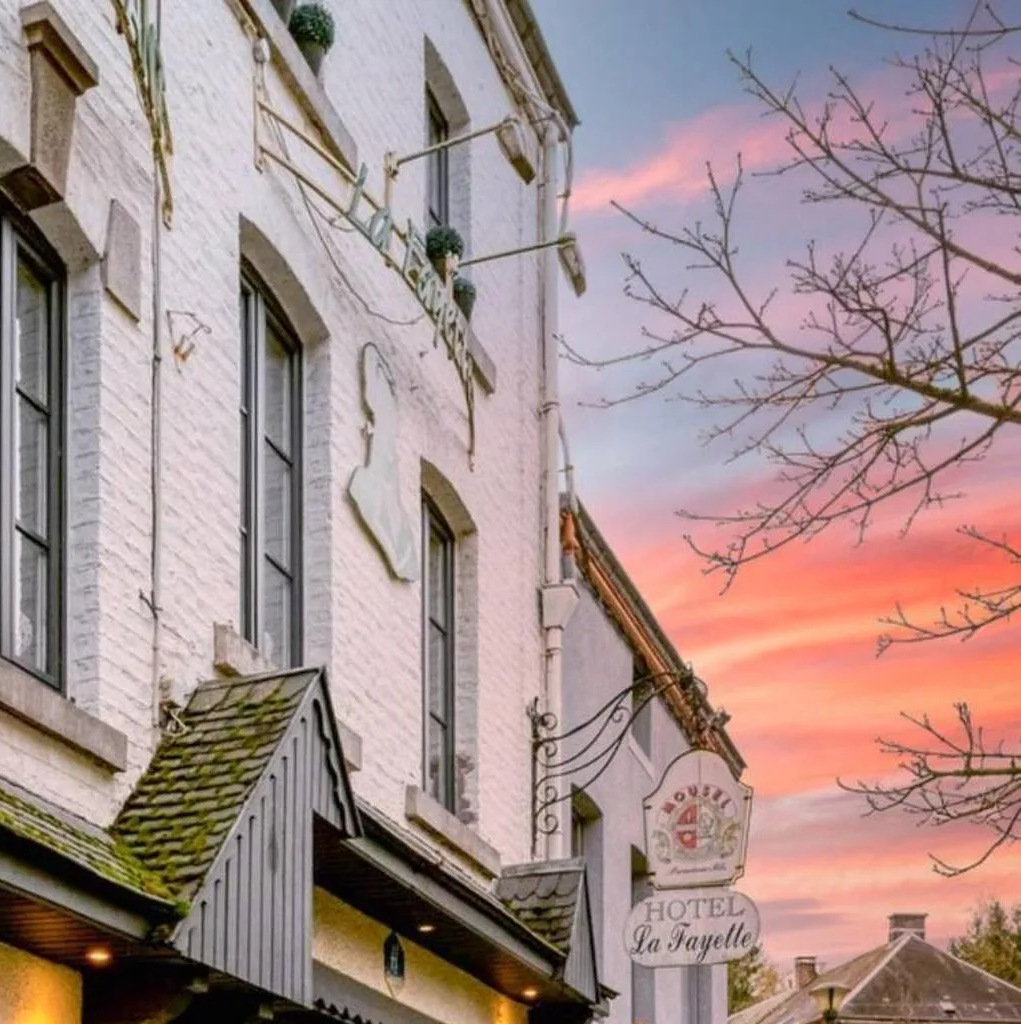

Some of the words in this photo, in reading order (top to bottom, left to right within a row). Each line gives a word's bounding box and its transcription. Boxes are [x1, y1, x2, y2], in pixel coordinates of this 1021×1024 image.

[347, 163, 392, 250] La
[662, 785, 731, 814] MOUSEL
[646, 898, 745, 922] HOTEL
[631, 925, 661, 955] La
[669, 923, 752, 960] Fayette
